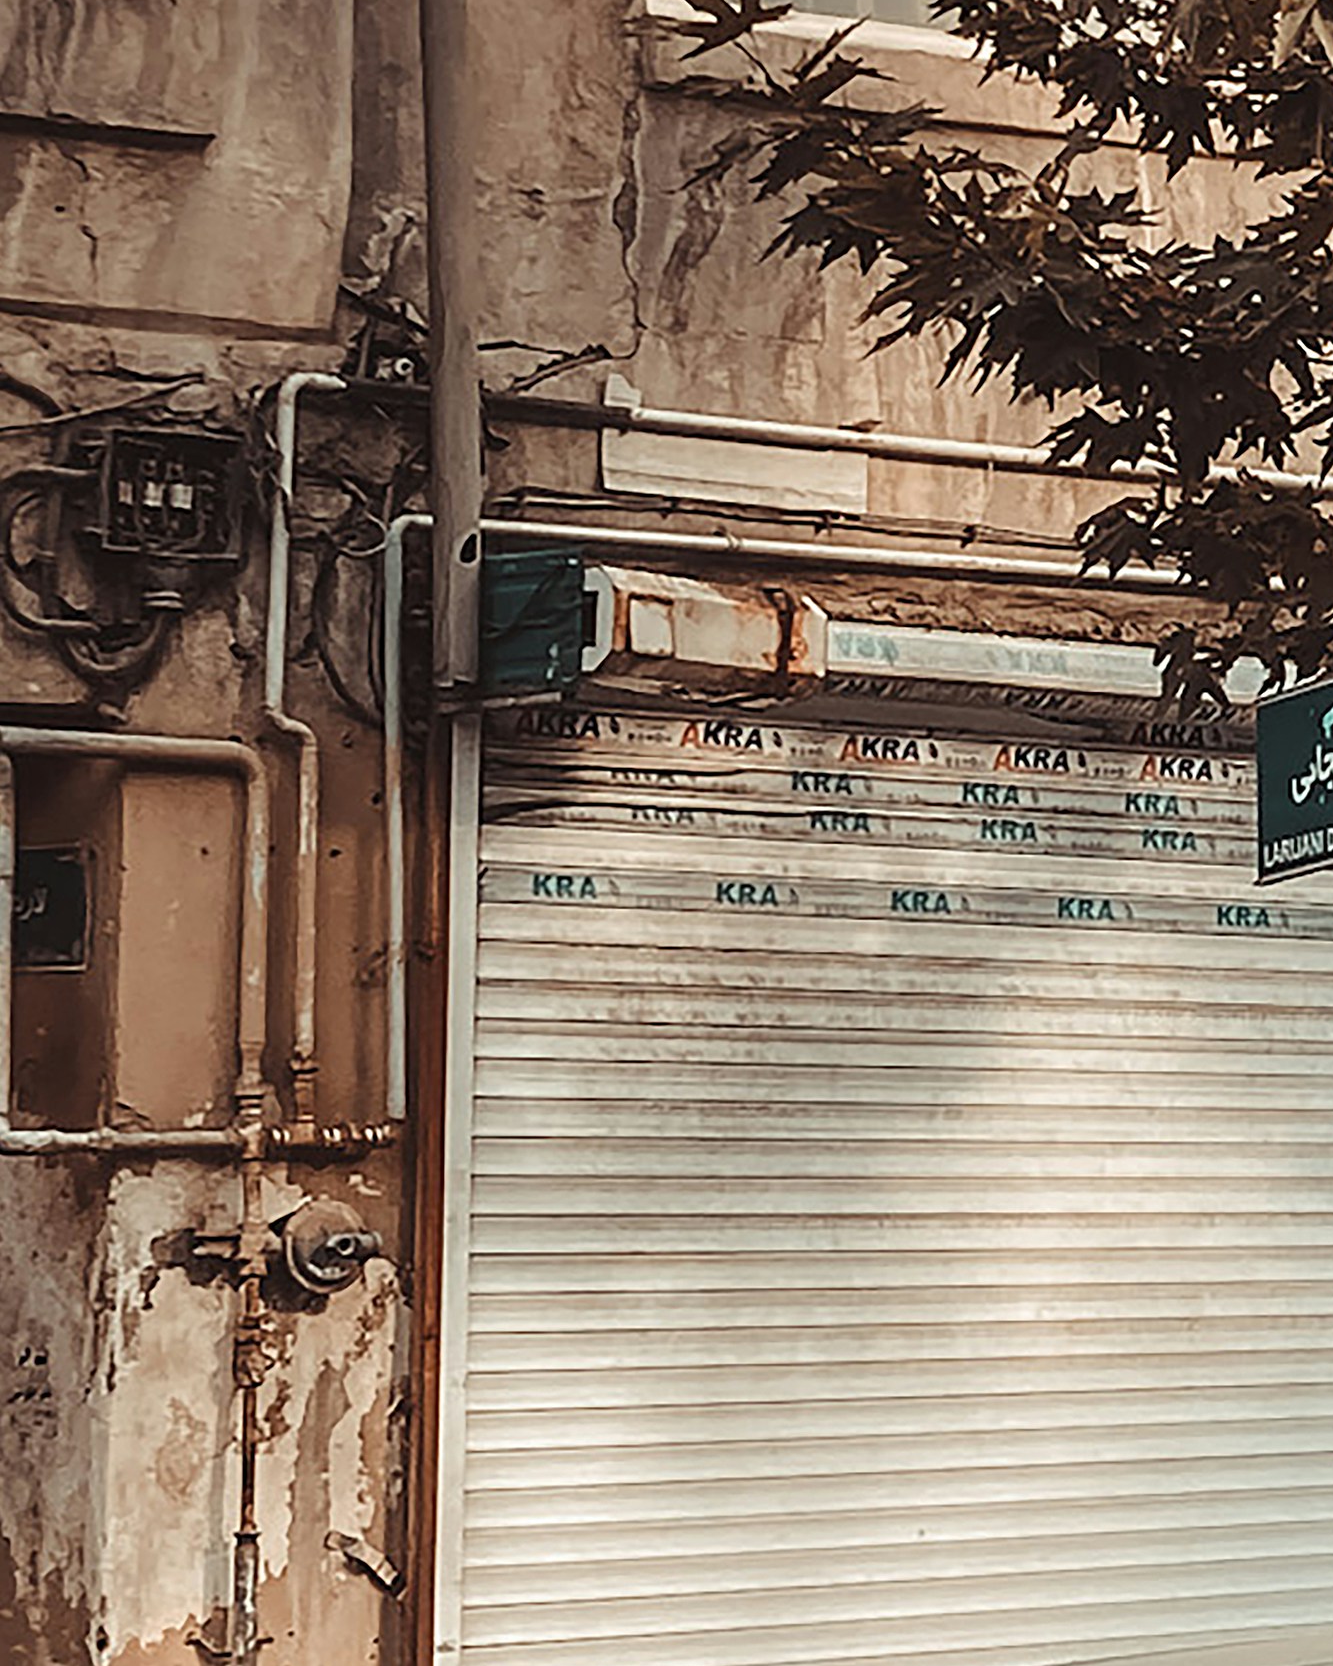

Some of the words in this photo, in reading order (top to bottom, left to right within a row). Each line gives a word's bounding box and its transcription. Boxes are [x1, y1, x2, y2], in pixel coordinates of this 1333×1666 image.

[680, 720, 763, 750] AKRA
[840, 735, 920, 762] AKRA
[993, 745, 1070, 773] AKRA
[1139, 754, 1212, 781] AKRA
[790, 771, 852, 795] KRA
[961, 783, 1020, 805] KRA
[1124, 793, 1180, 816] KRA
[810, 812, 870, 833] KRA
[980, 819, 1038, 844] KRA
[1142, 829, 1197, 853] KRA
[531, 873, 597, 899] KRA
[716, 882, 779, 907] KRA
[891, 890, 952, 915] KRA
[1057, 897, 1115, 922] KRA
[1216, 906, 1271, 929] KRA
